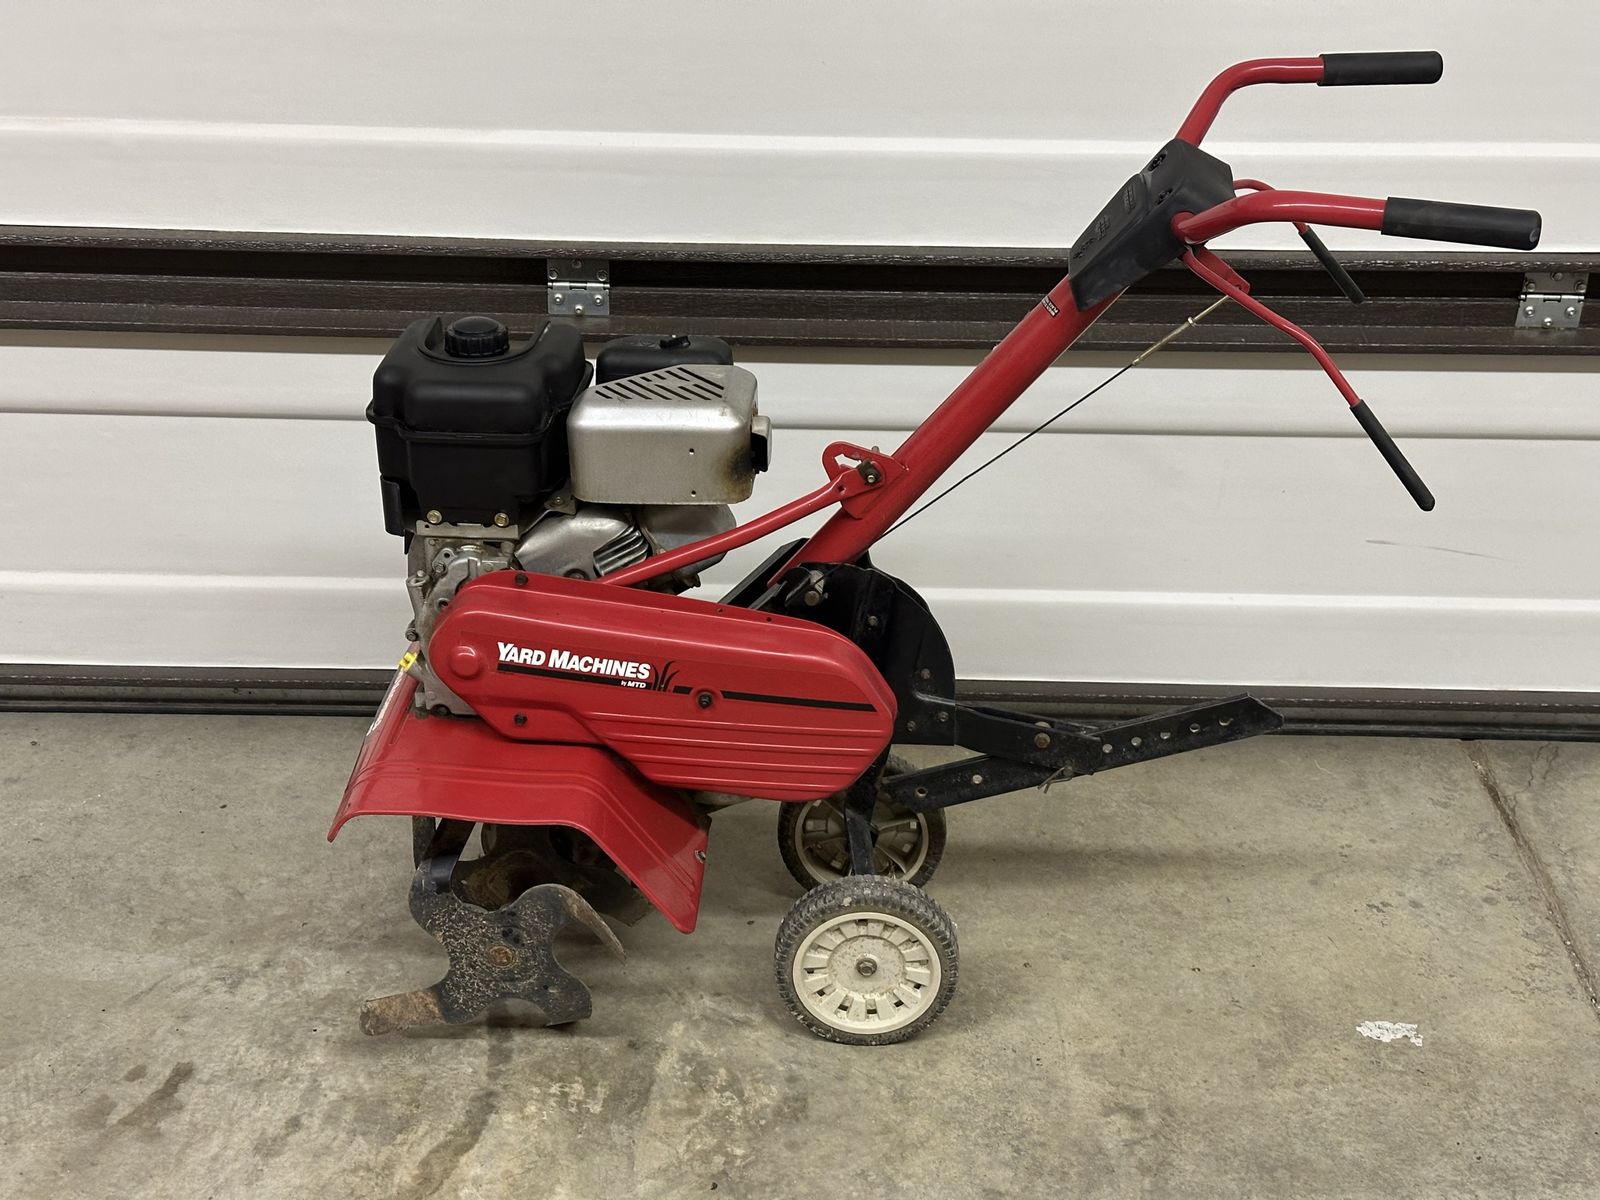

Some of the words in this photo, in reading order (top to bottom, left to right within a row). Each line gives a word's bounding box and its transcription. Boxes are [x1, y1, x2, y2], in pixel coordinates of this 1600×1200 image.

[497, 641, 546, 665] YARD
[548, 649, 651, 679] MACHINES
[627, 680, 647, 689] MTD
